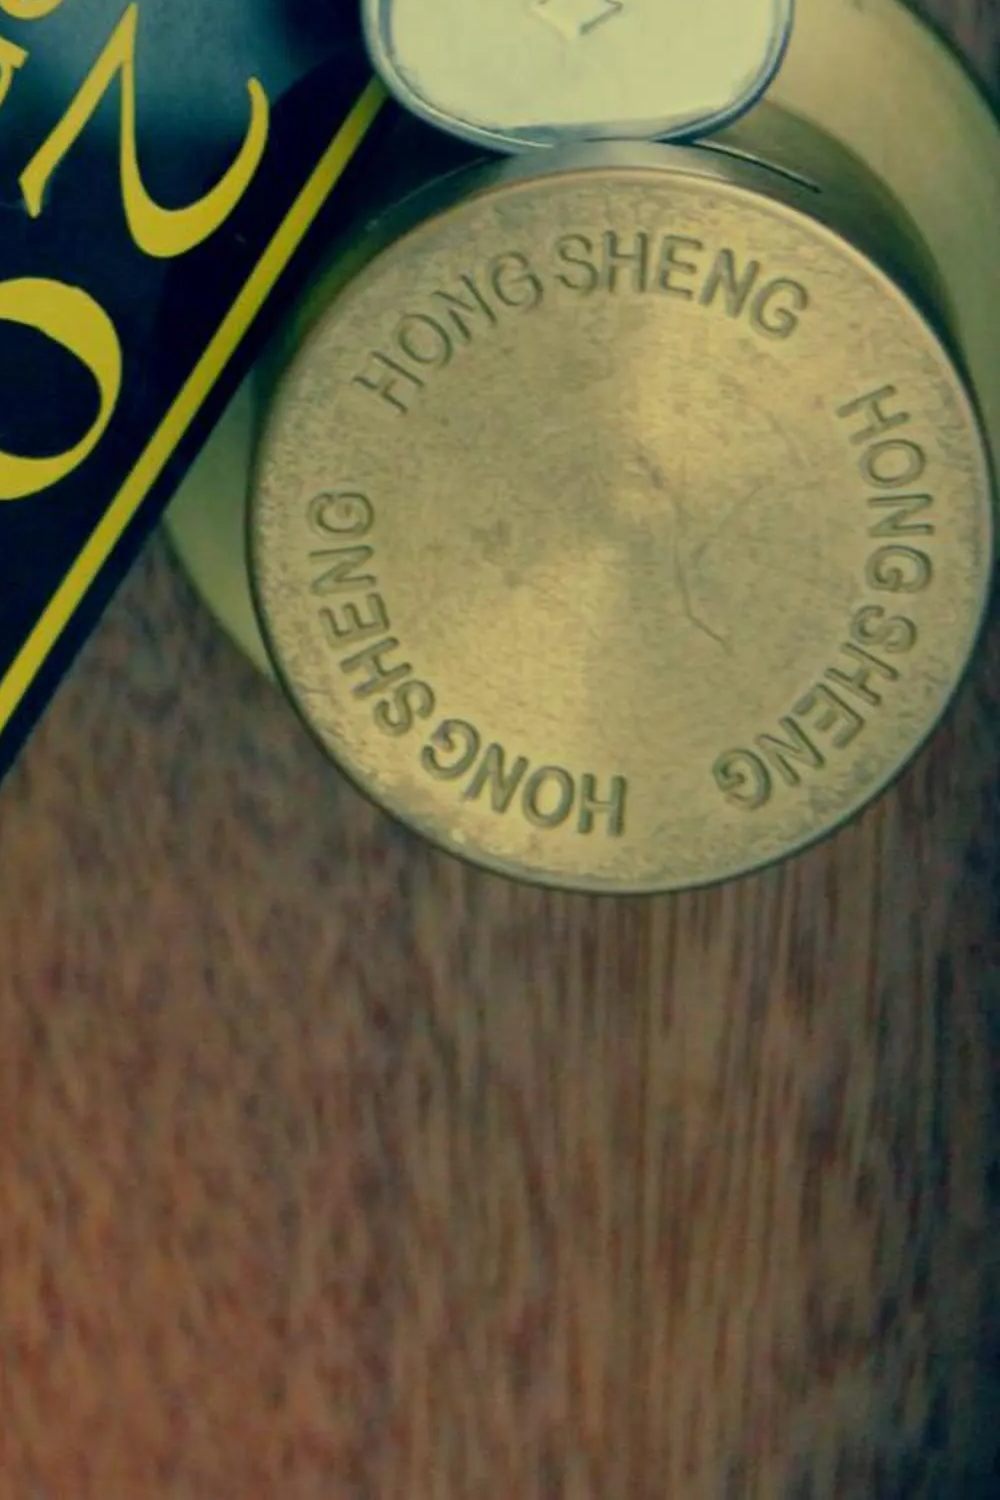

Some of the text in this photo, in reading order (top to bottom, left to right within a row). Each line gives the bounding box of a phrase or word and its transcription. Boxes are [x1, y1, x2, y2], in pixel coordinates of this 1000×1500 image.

[352, 231, 810, 415] HONG SHENG
[307, 490, 628, 837] HONG SHENG
[711, 384, 934, 811] HONG SHENG
